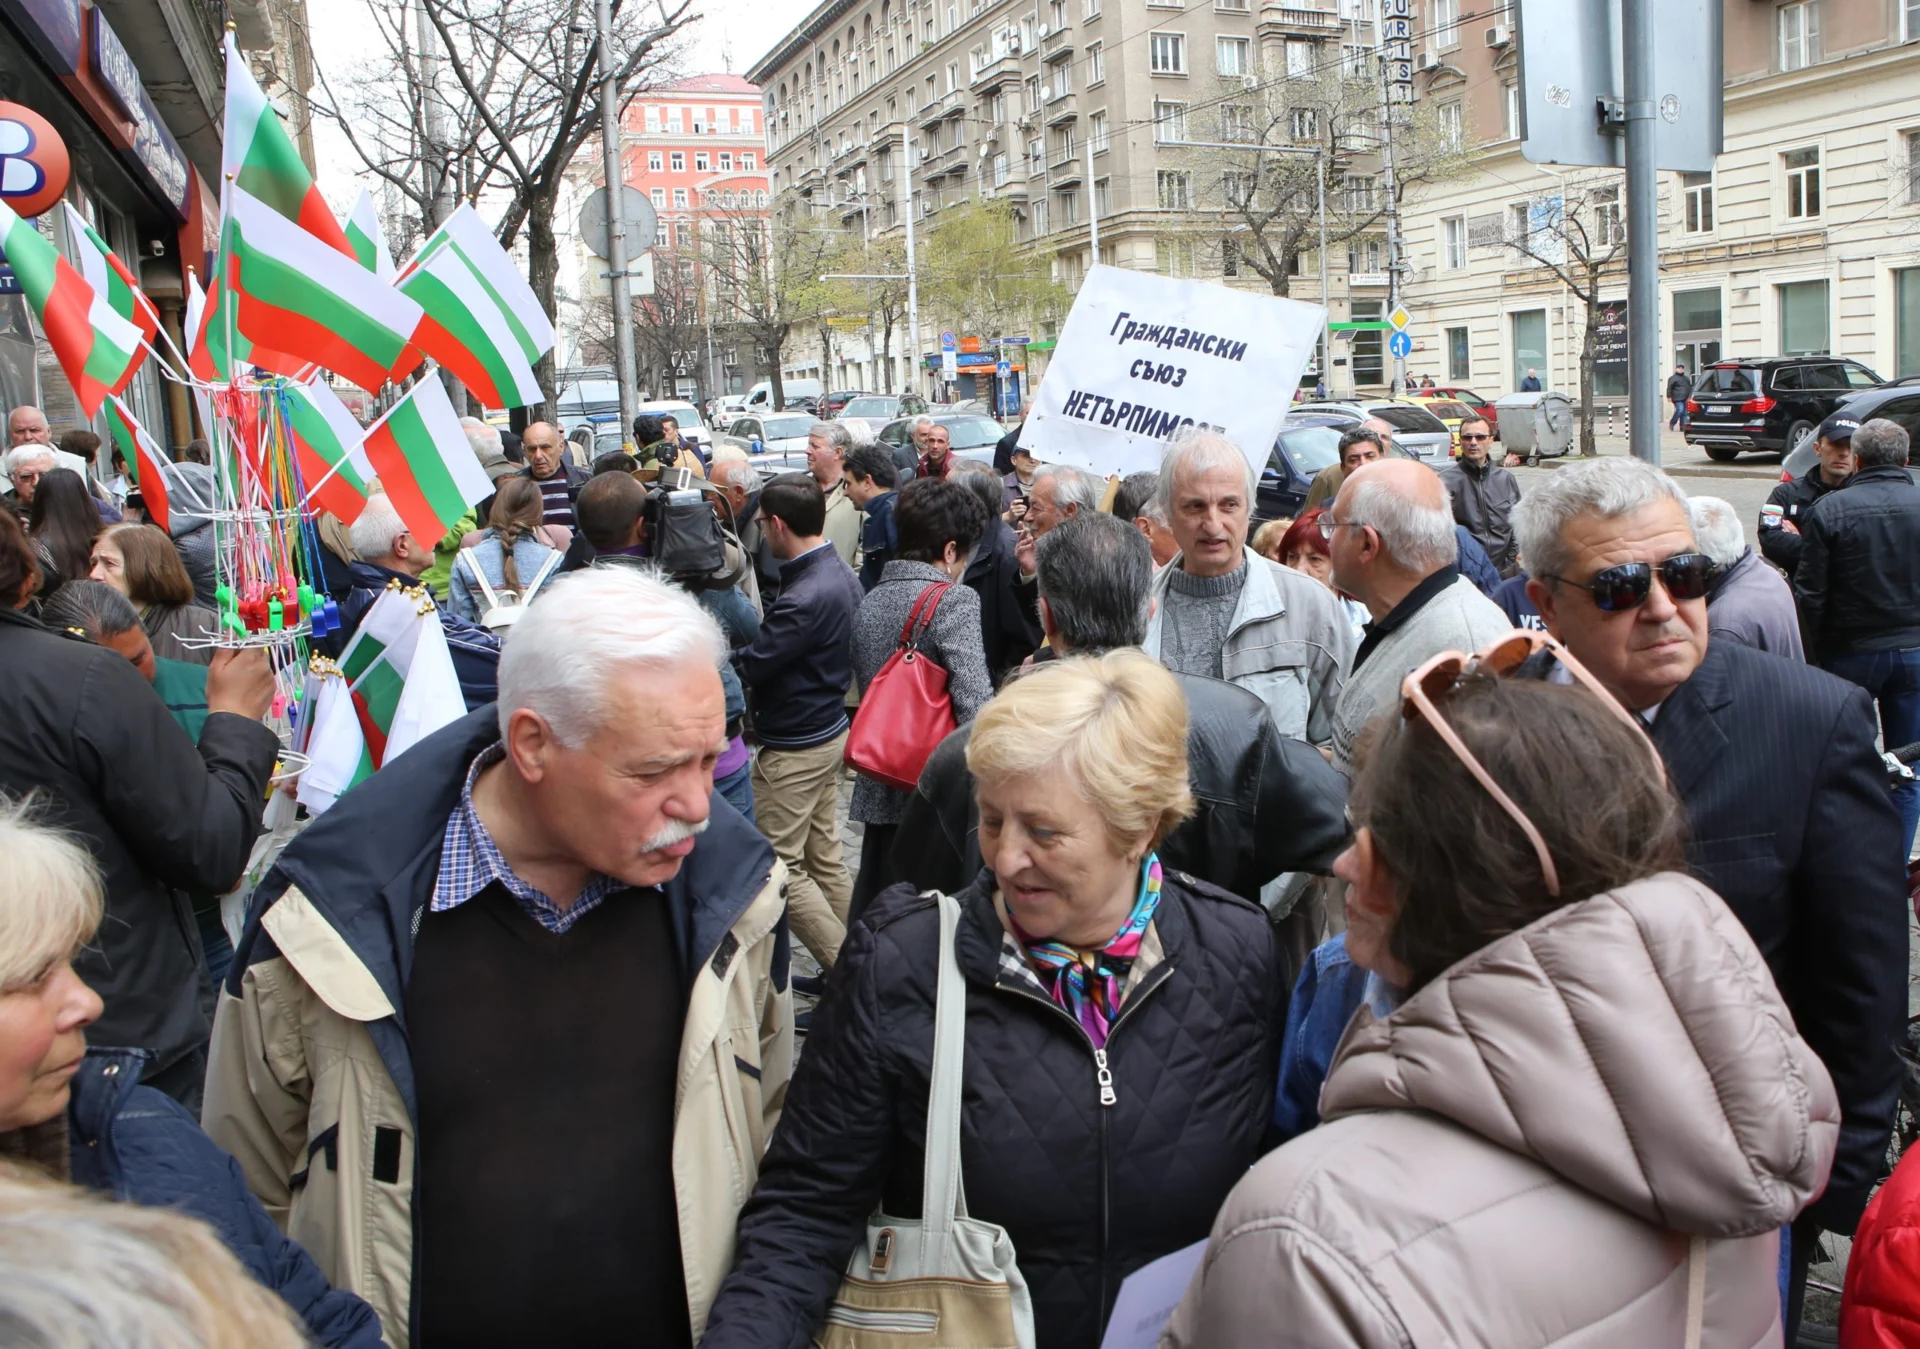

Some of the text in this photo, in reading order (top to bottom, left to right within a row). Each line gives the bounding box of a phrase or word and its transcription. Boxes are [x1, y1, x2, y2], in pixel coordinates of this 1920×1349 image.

[1109, 312, 1248, 362] Граждански
[1129, 359, 1187, 388] съюз
[1062, 390, 1226, 442] НЕТЪРПИМ
